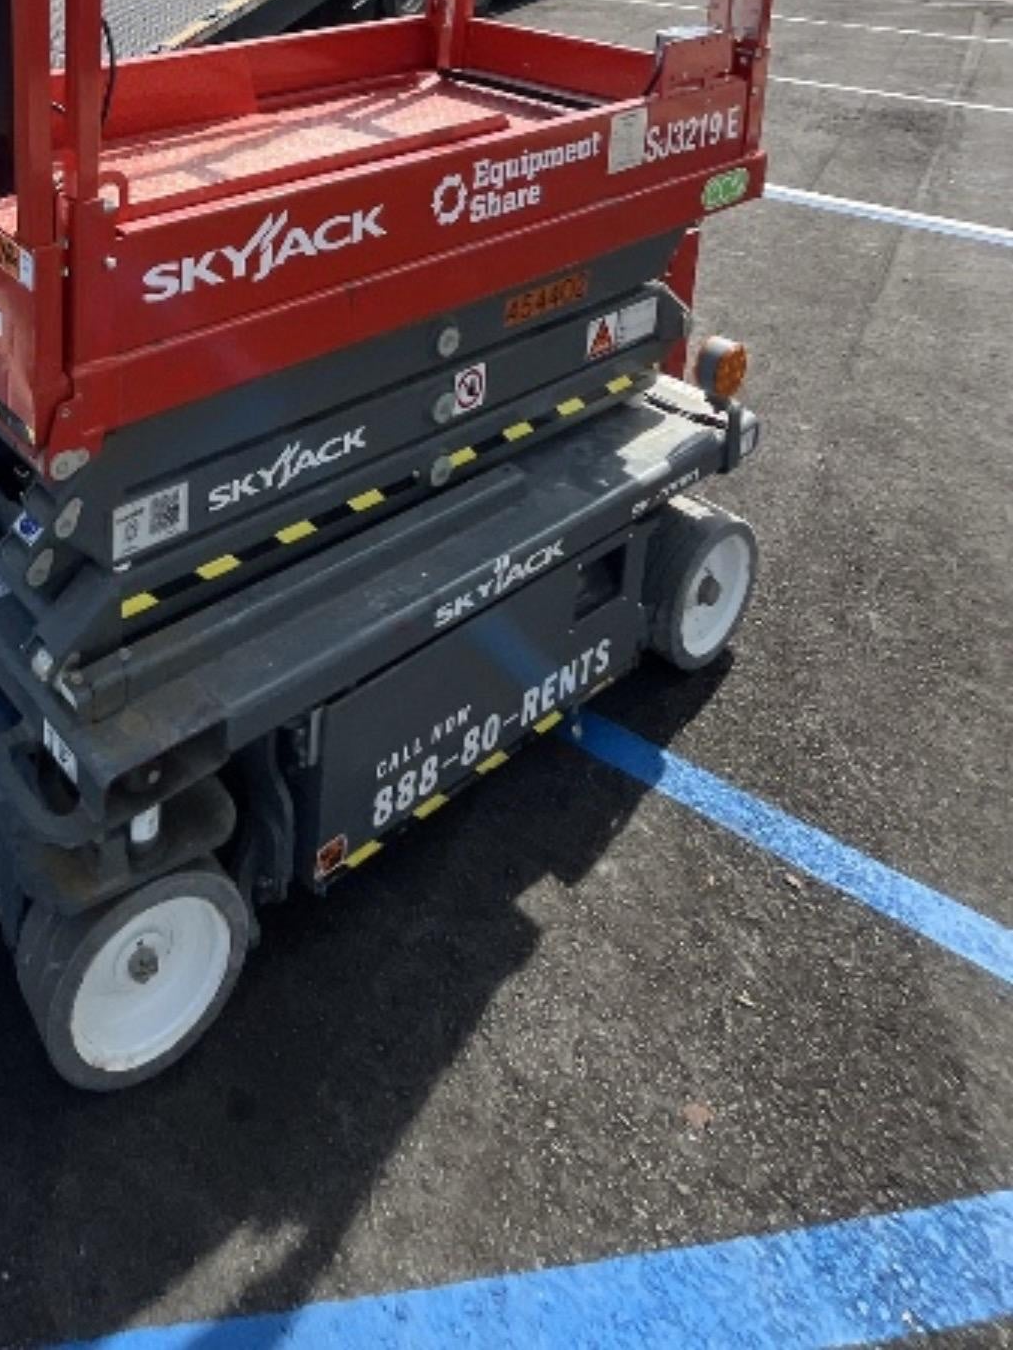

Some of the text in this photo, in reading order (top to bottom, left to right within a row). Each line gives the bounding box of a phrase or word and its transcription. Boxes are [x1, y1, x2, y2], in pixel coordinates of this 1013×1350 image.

[469, 183, 541, 223] Share
[472, 131, 603, 191] Equipment
[141, 202, 388, 304] SKYJACK
[207, 424, 367, 512] SKYJACK
[434, 537, 565, 629] SKYJACK
[372, 637, 613, 827] 888-80-RENTS
[375, 703, 472, 779] CALL NOW
